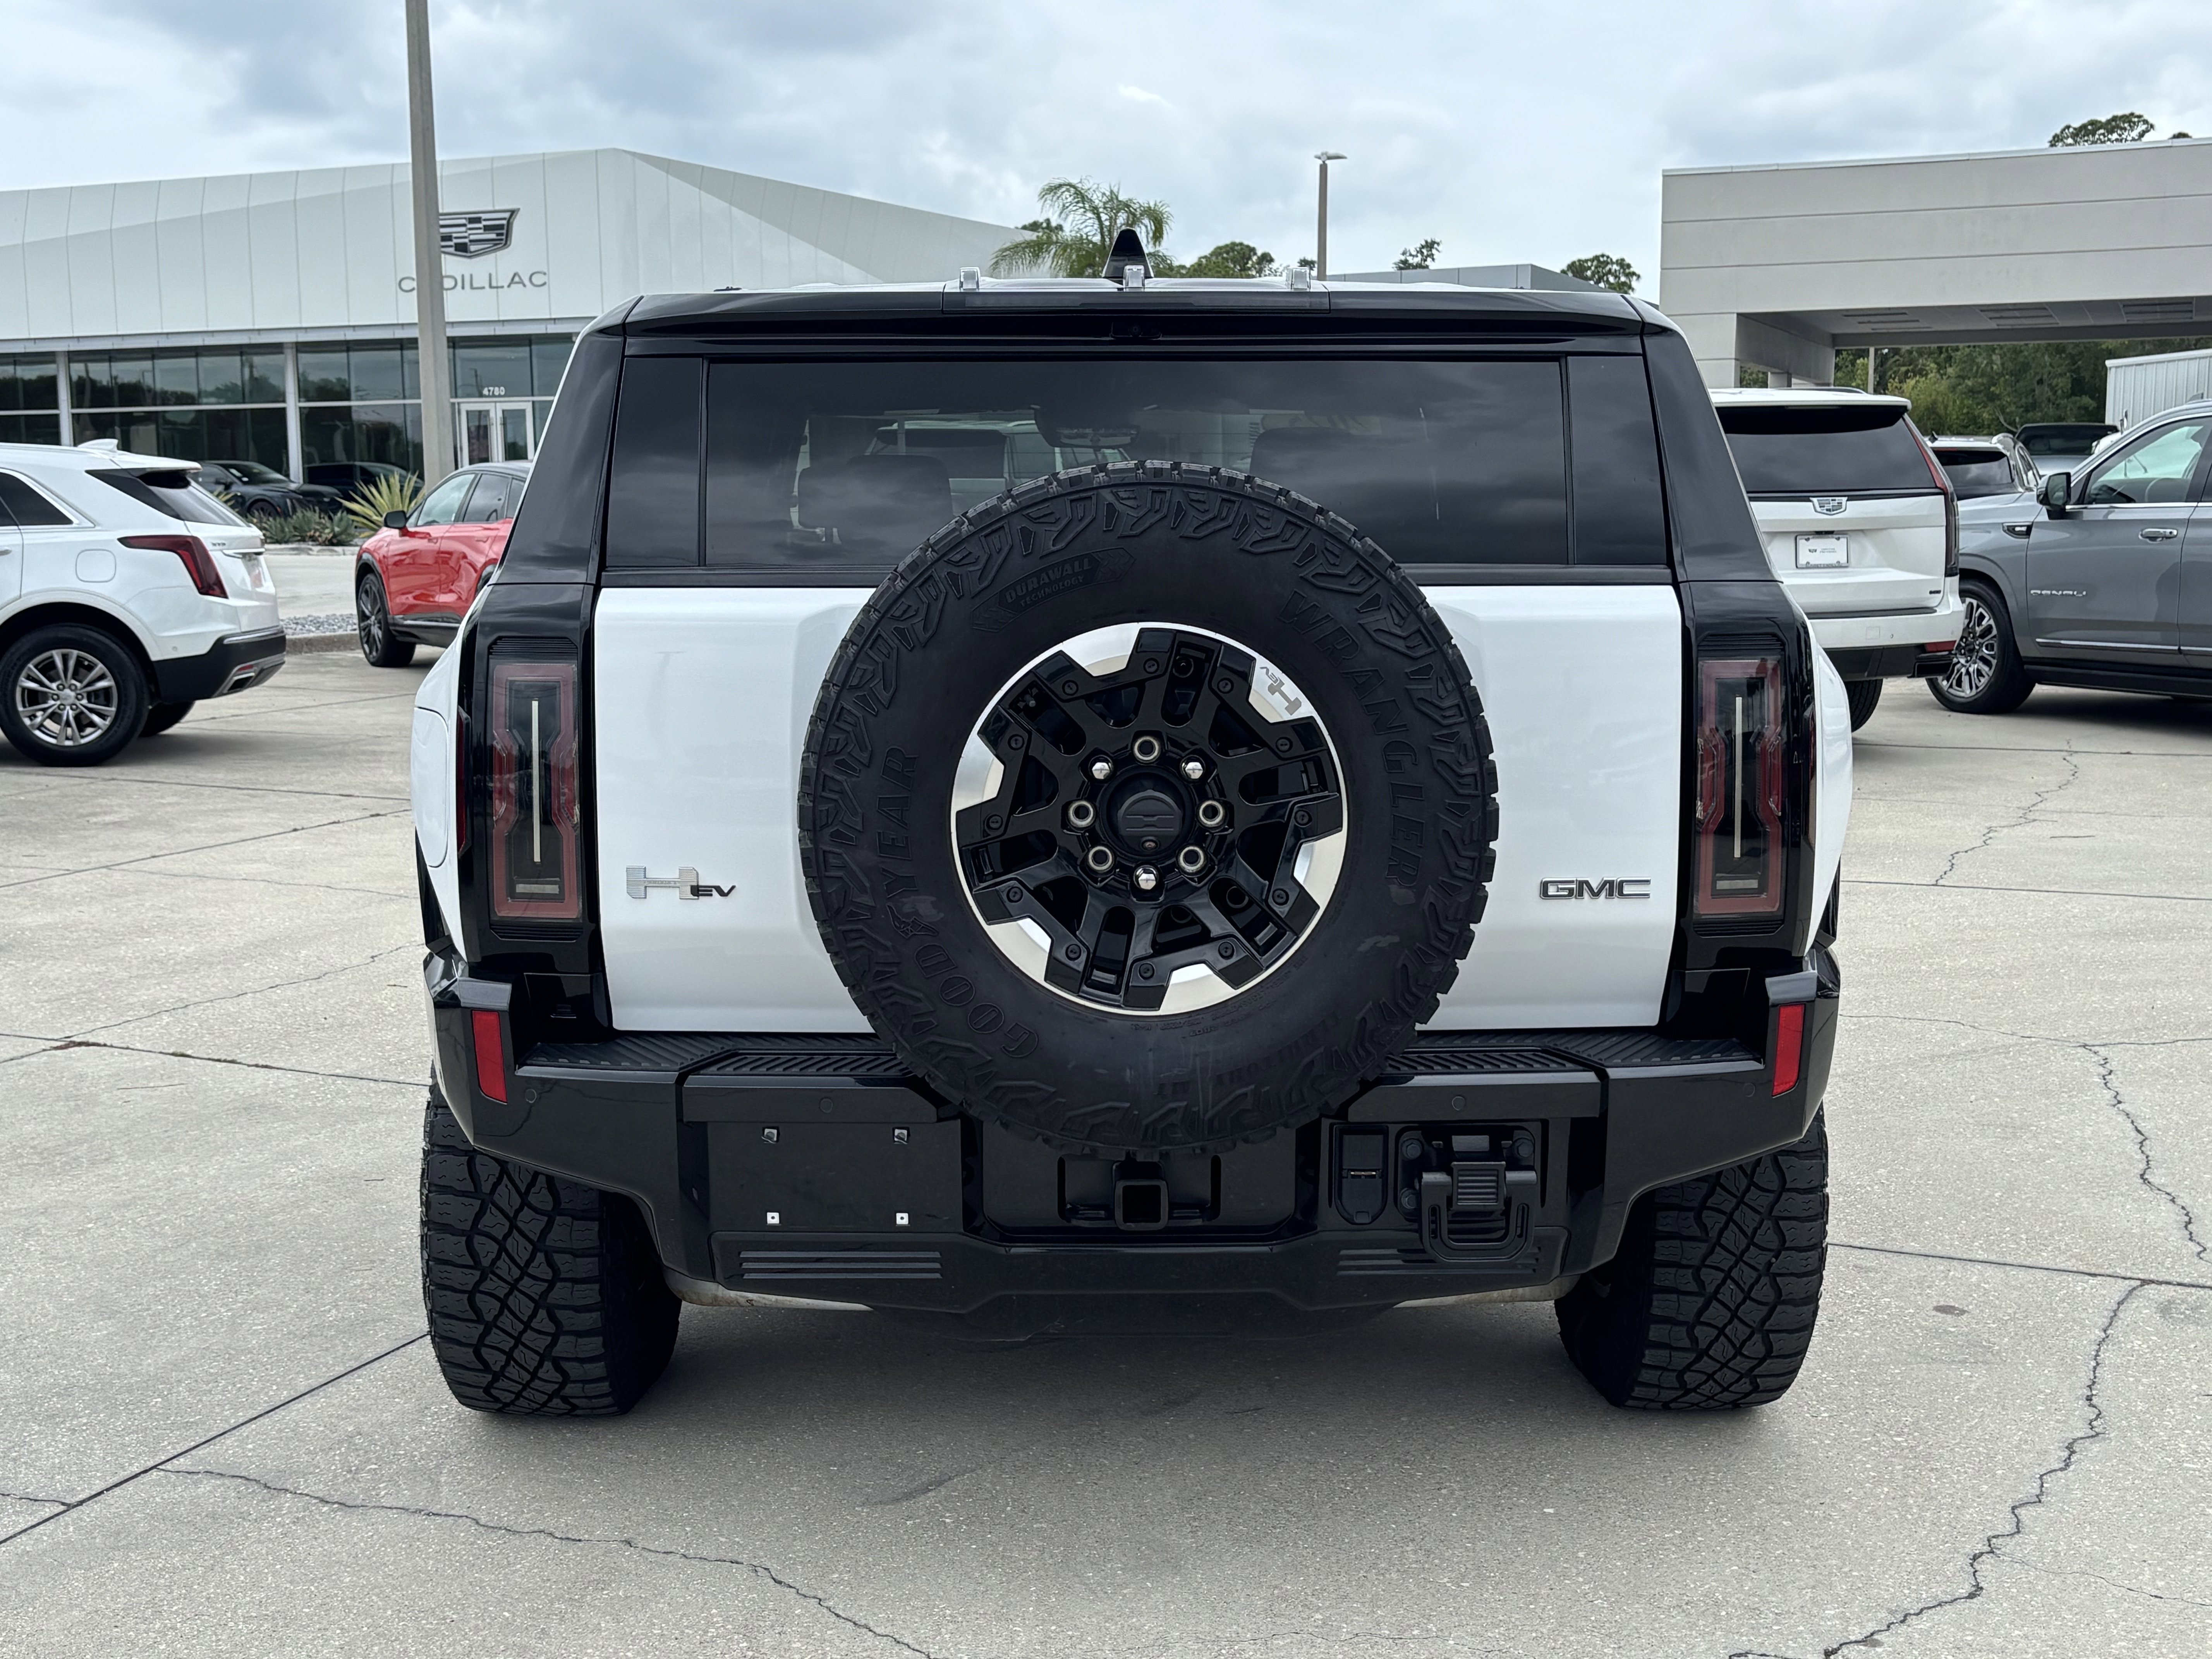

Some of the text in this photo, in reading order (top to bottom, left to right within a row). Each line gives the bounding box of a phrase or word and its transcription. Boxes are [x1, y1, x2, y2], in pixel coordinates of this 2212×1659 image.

[398, 271, 547, 292] CDILLAC
[483, 386, 505, 396] 4780
[1006, 558, 1092, 603] DURAWALL
[1020, 575, 1084, 607] TECHNOLOGY
[1278, 590, 1425, 888] WRANGLER
[1540, 877, 1651, 899] GMC
